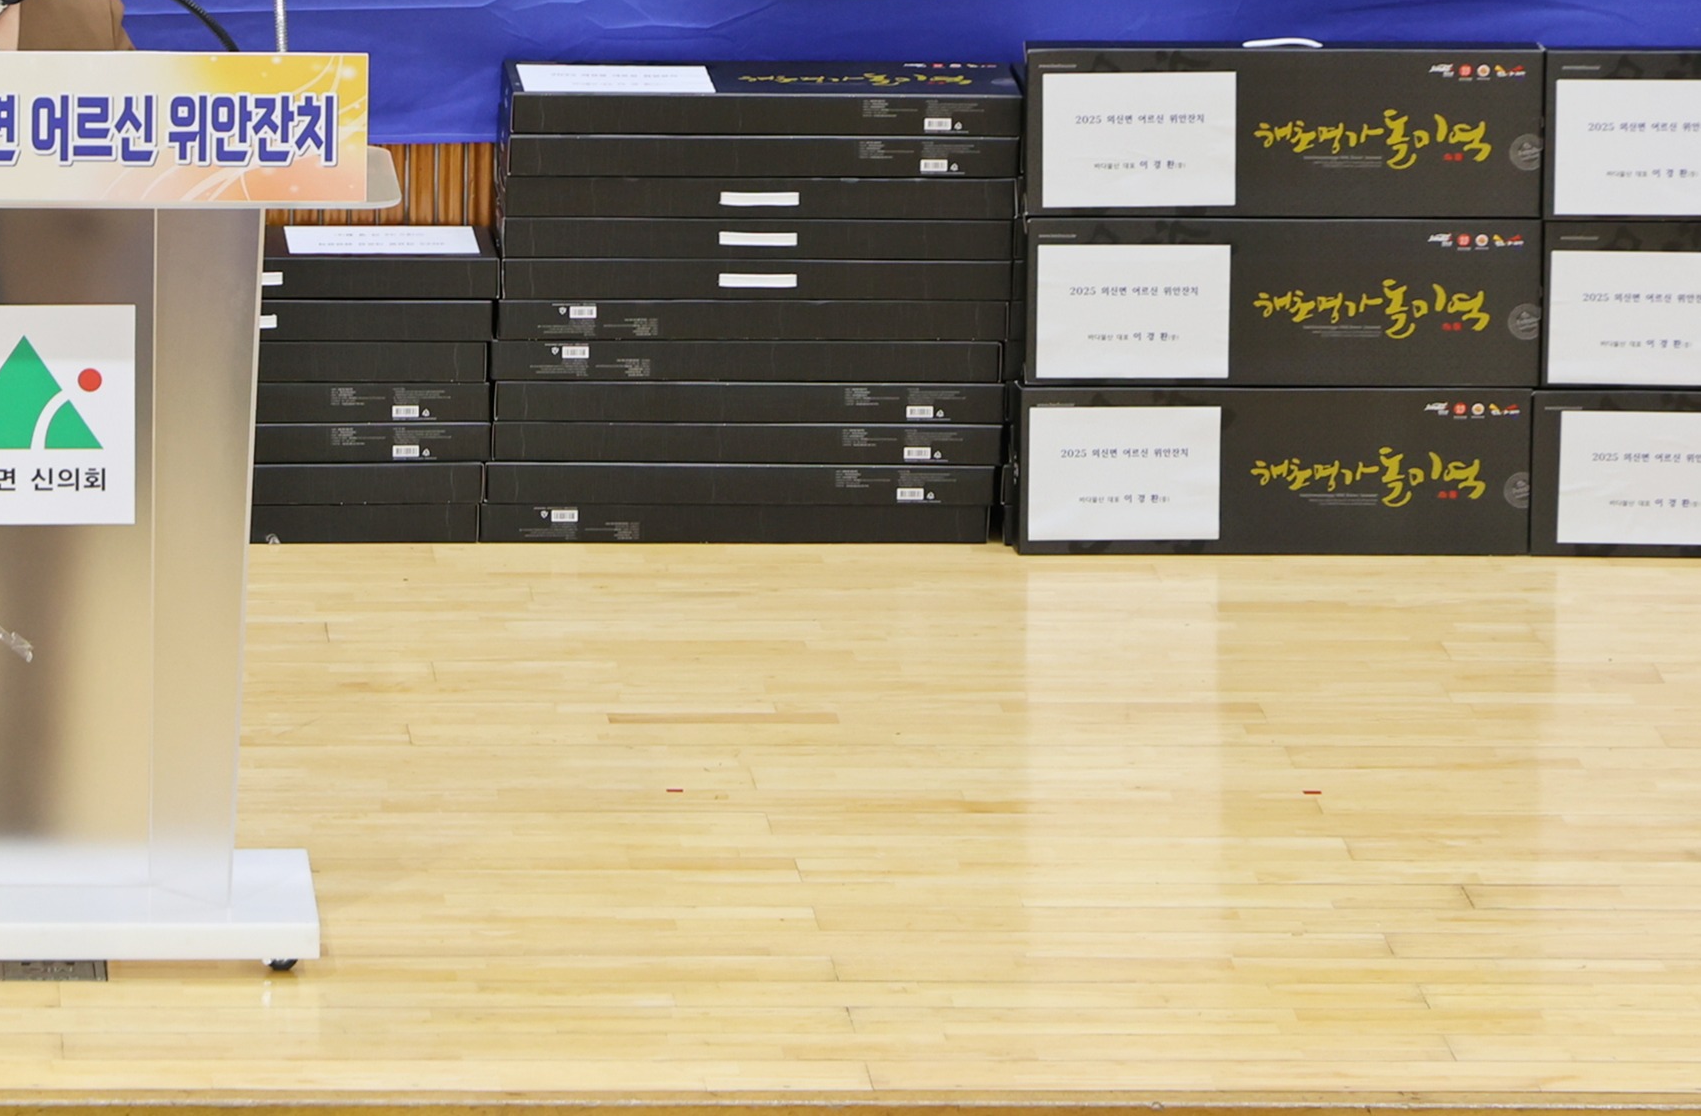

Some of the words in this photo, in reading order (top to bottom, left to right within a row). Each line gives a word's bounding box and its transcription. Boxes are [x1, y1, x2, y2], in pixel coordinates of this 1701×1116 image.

[1075, 114, 1103, 125] 2025
[1106, 114, 1133, 125] 의신면
[1137, 113, 1165, 125] 어르신
[1169, 113, 1205, 125] 위안잔치
[32, 94, 156, 164] 어르신
[168, 94, 337, 165] 위안잔치
[1587, 121, 1616, 132] 2025
[1619, 121, 1647, 133] 의신면
[1650, 121, 1678, 133] 어르신
[1254, 119, 1385, 155] 해초명가
[1382, 109, 1493, 171] 돌미역
[1069, 285, 1097, 297] 2025
[1100, 286, 1128, 297] 의신면
[1131, 285, 1159, 297] 어르신
[1163, 285, 1199, 297] 위안잔치
[1582, 292, 1610, 303] 2025
[1613, 292, 1641, 304] 의신면
[1645, 293, 1673, 304] 어르신
[1253, 289, 1384, 324] 해초명가
[1380, 279, 1492, 341] 돌미역
[1060, 448, 1088, 459] 2025
[1091, 447, 1118, 459] 의신면
[1122, 447, 1149, 459] 어르신
[1153, 447, 1189, 459] 위안잔치
[1591, 451, 1620, 462] 2025
[1623, 452, 1650, 463] 의신면
[1654, 452, 1682, 464] 어르신
[31, 468, 108, 493] 신의회
[1250, 457, 1380, 493] 해초명가
[1376, 447, 1488, 509] 돌미역
